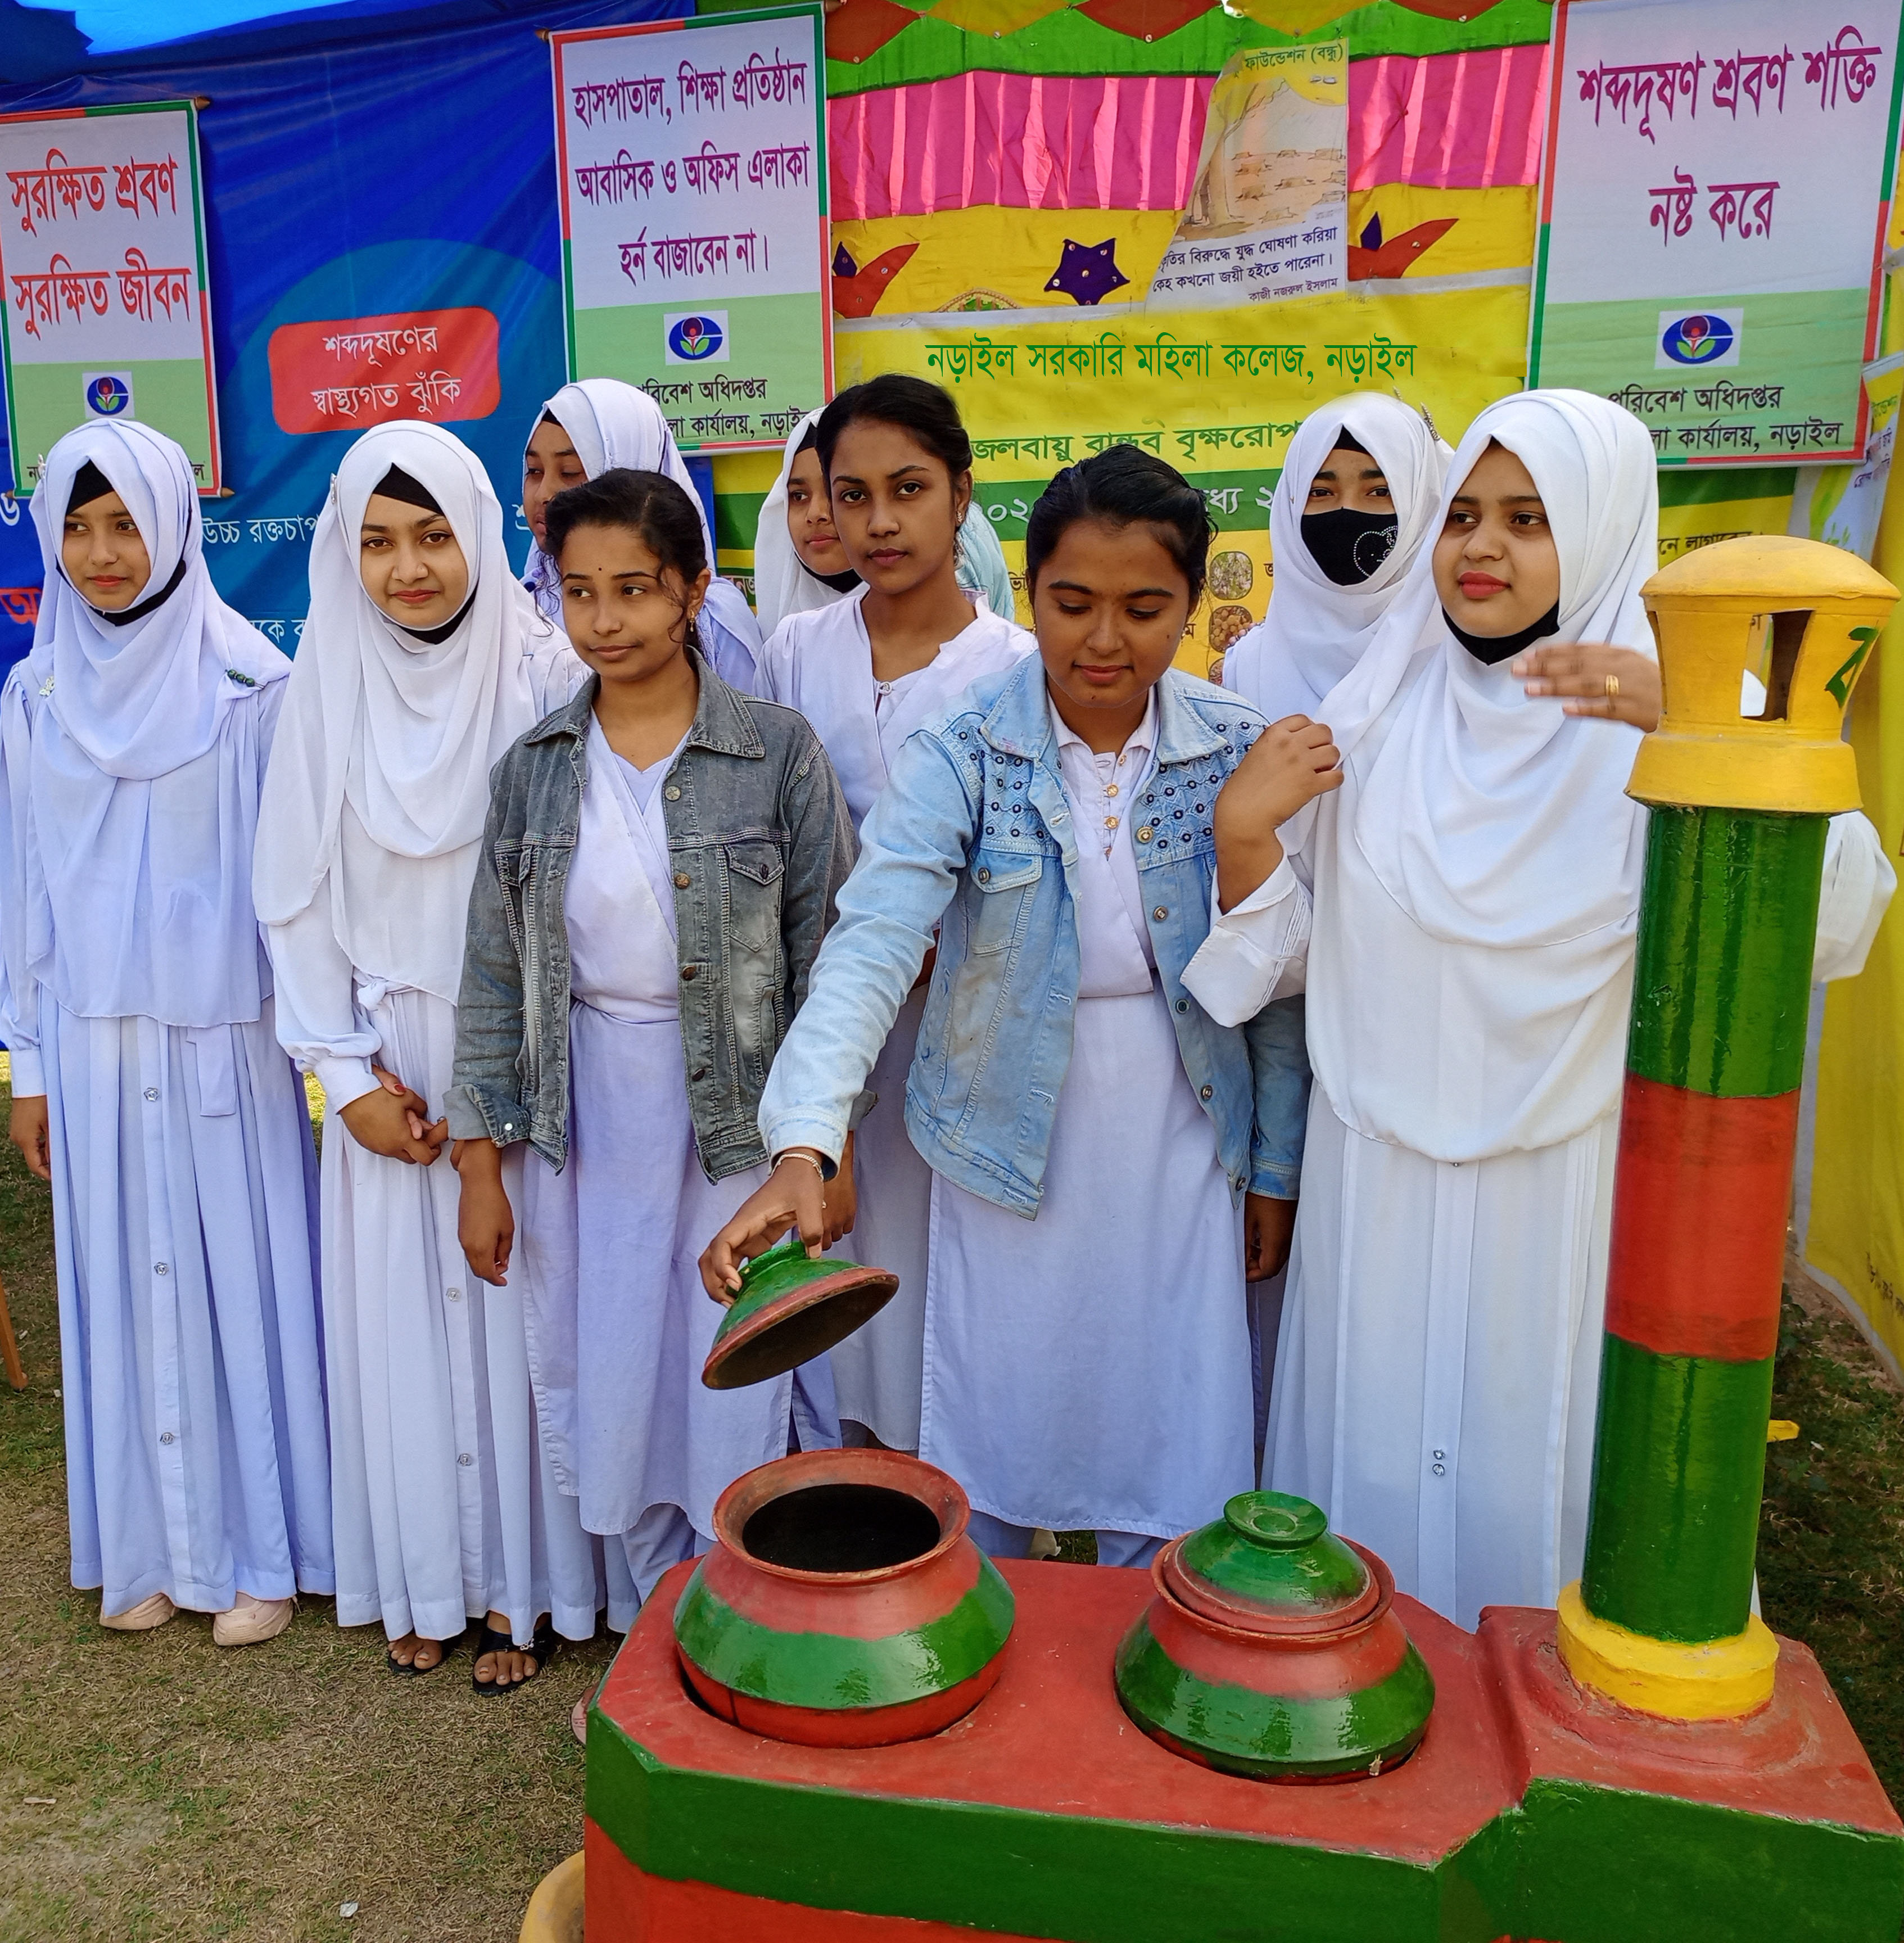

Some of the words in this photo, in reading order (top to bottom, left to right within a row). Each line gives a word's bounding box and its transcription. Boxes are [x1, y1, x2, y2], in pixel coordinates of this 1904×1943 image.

[1245, 49, 1306, 71] ফাউন্ডেশন
[572, 74, 671, 130] হাসপাতাল,
[677, 60, 725, 115] শিক্ষা
[732, 47, 807, 111] প্রতিষ্ঠান
[1576, 51, 1706, 144] শব্দদূষণ
[1712, 43, 1794, 120] শ্রবণ
[1802, 25, 1882, 111] শক্তি
[7, 148, 107, 237] সুরক্ষিত
[113, 153, 178, 220] শ্রবণ
[575, 148, 654, 206] আবাসিক
[662, 160, 677, 194] ও
[682, 140, 740, 196] অফিস
[748, 140, 810, 191] এলাকা
[1648, 165, 1698, 247] নষ্ট
[1707, 181, 1780, 242] করে
[618, 226, 646, 287] হর্ন
[652, 233, 729, 279] বাজাবেন
[1190, 247, 1231, 264] বিরুদ্ধে
[1234, 243, 1255, 260] যুদ্ধ
[1259, 234, 1298, 254] ঘোষণা
[1301, 226, 1338, 245] করিয়া
[11, 254, 110, 341] সুরক্ষিত
[117, 247, 192, 323] জীবন
[1153, 278, 1173, 292] কেহ
[1175, 273, 1215, 288] কখনো
[1219, 265, 1244, 283] জয়ী
[1247, 262, 1281, 280] হইতে
[1249, 287, 1270, 302] কাজী
[1273, 284, 1303, 297] নজরুল
[1305, 278, 1338, 292] ইসলাম
[322, 326, 438, 368] শব্দদূষণের
[310, 383, 399, 419] স্বাস্থ্যগত
[405, 370, 462, 415] ঝুঁকি
[698, 374, 768, 403] অধিদপ্তর
[1694, 380, 1784, 413] অধিদপ্তর
[689, 408, 755, 439] কার্যালয়,
[759, 405, 810, 436] নড়াই
[970, 435, 1075, 464] জলবায়ু
[1173, 421, 1304, 462] বৃক্ষরোপ
[1676, 419, 1760, 453] কার্যালয়,
[1769, 415, 1844, 450] নড়াইল
